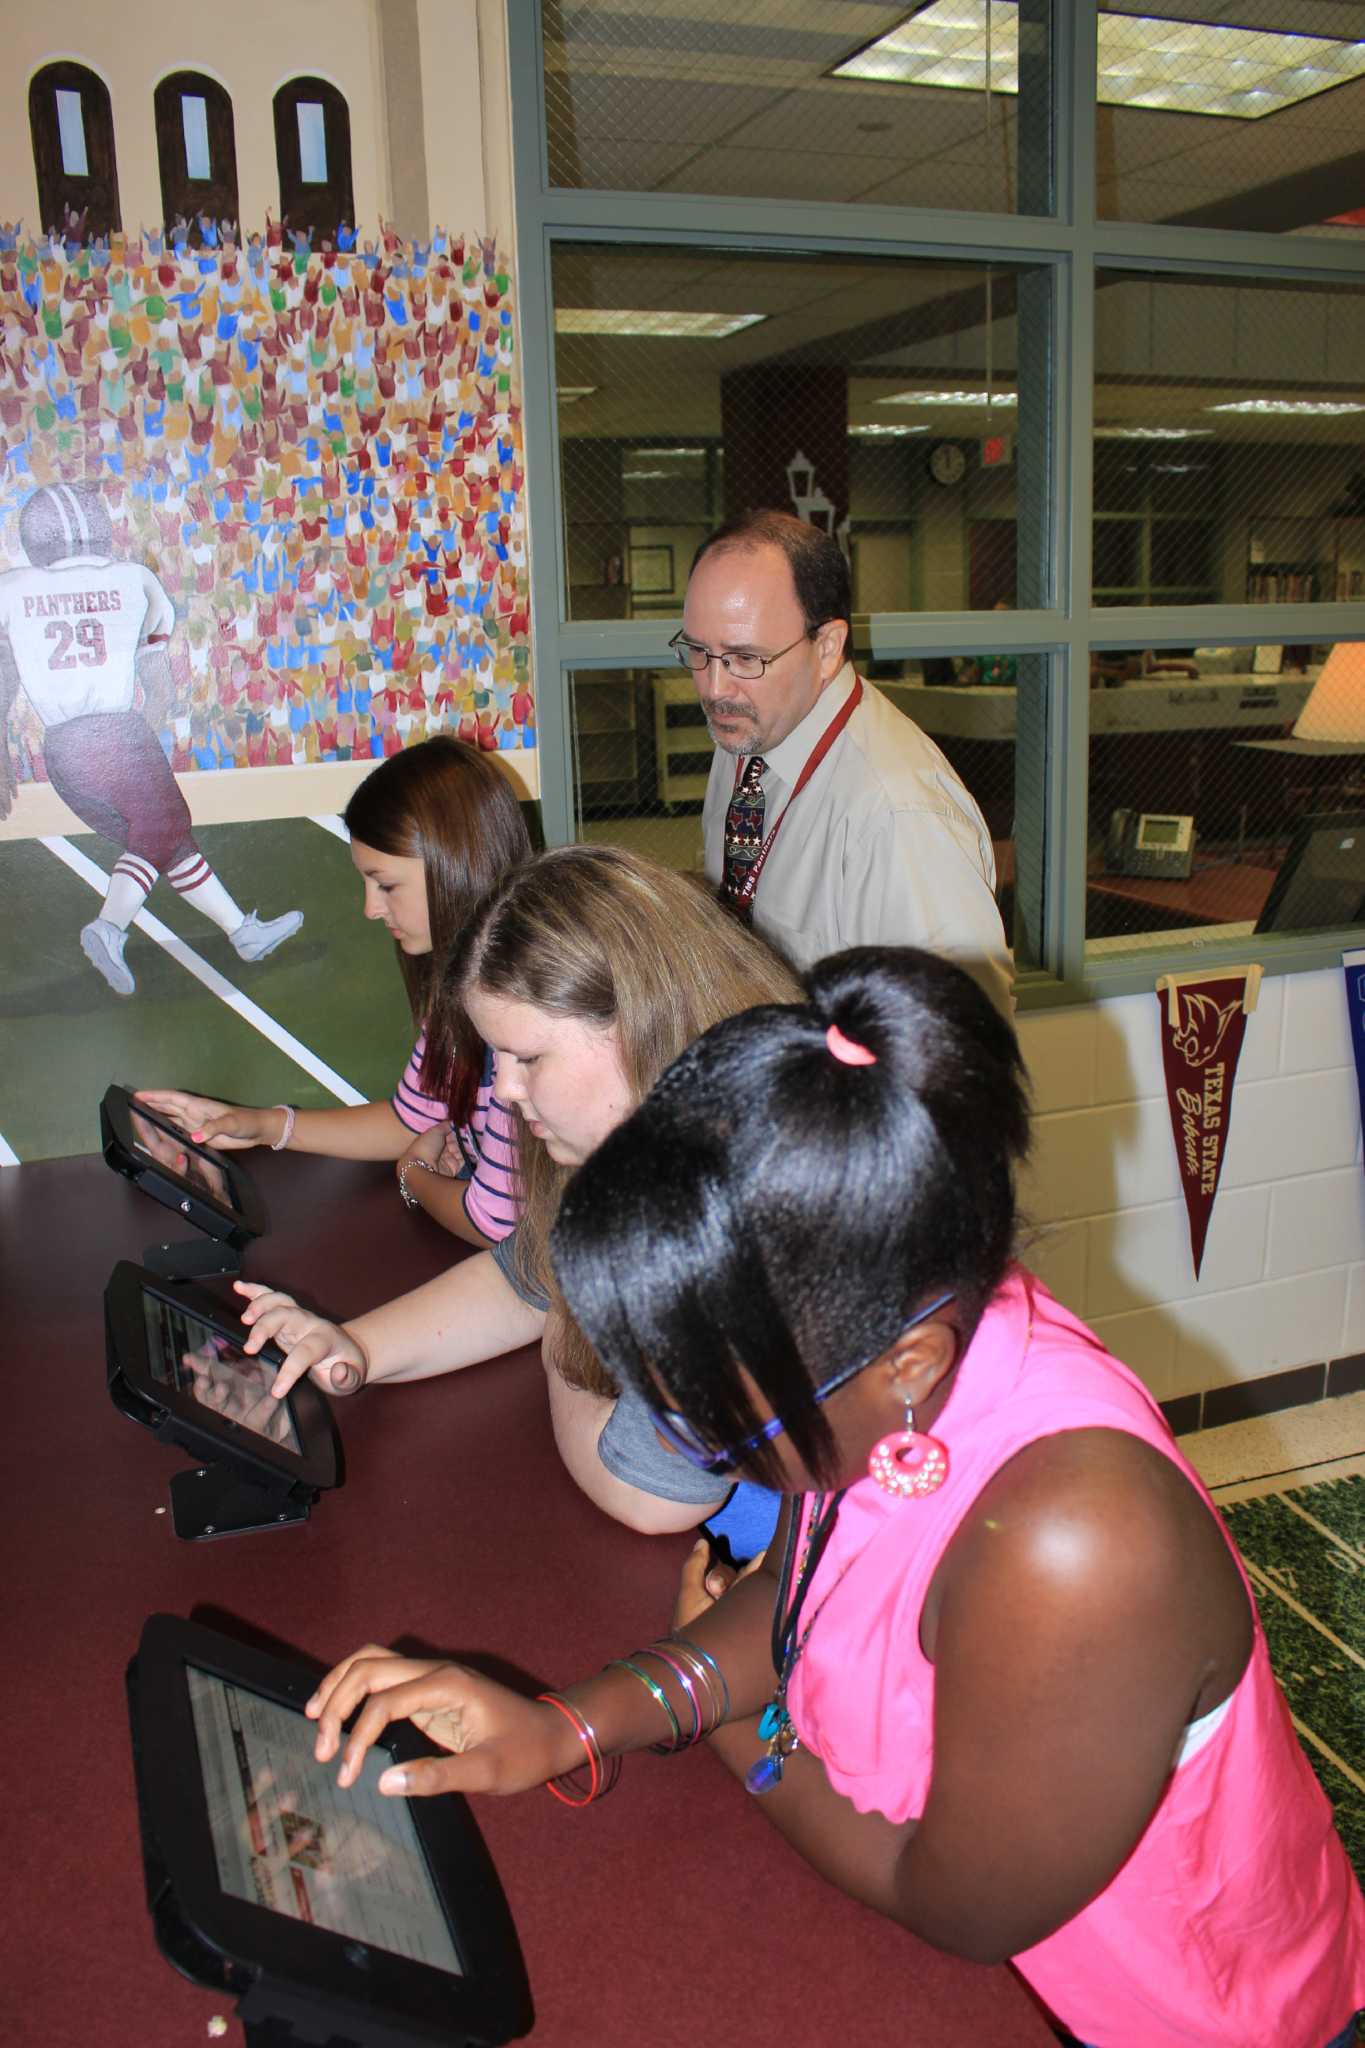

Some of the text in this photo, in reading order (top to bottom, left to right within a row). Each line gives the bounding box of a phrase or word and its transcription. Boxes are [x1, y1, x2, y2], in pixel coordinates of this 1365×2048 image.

[22, 590, 122, 618] PANTHERS
[44, 618, 108, 670] 29
[742, 876, 755, 896] TMS
[1176, 1088, 1202, 1176] Bobcats
[1201, 1062, 1225, 1194] TEXAS STATE
